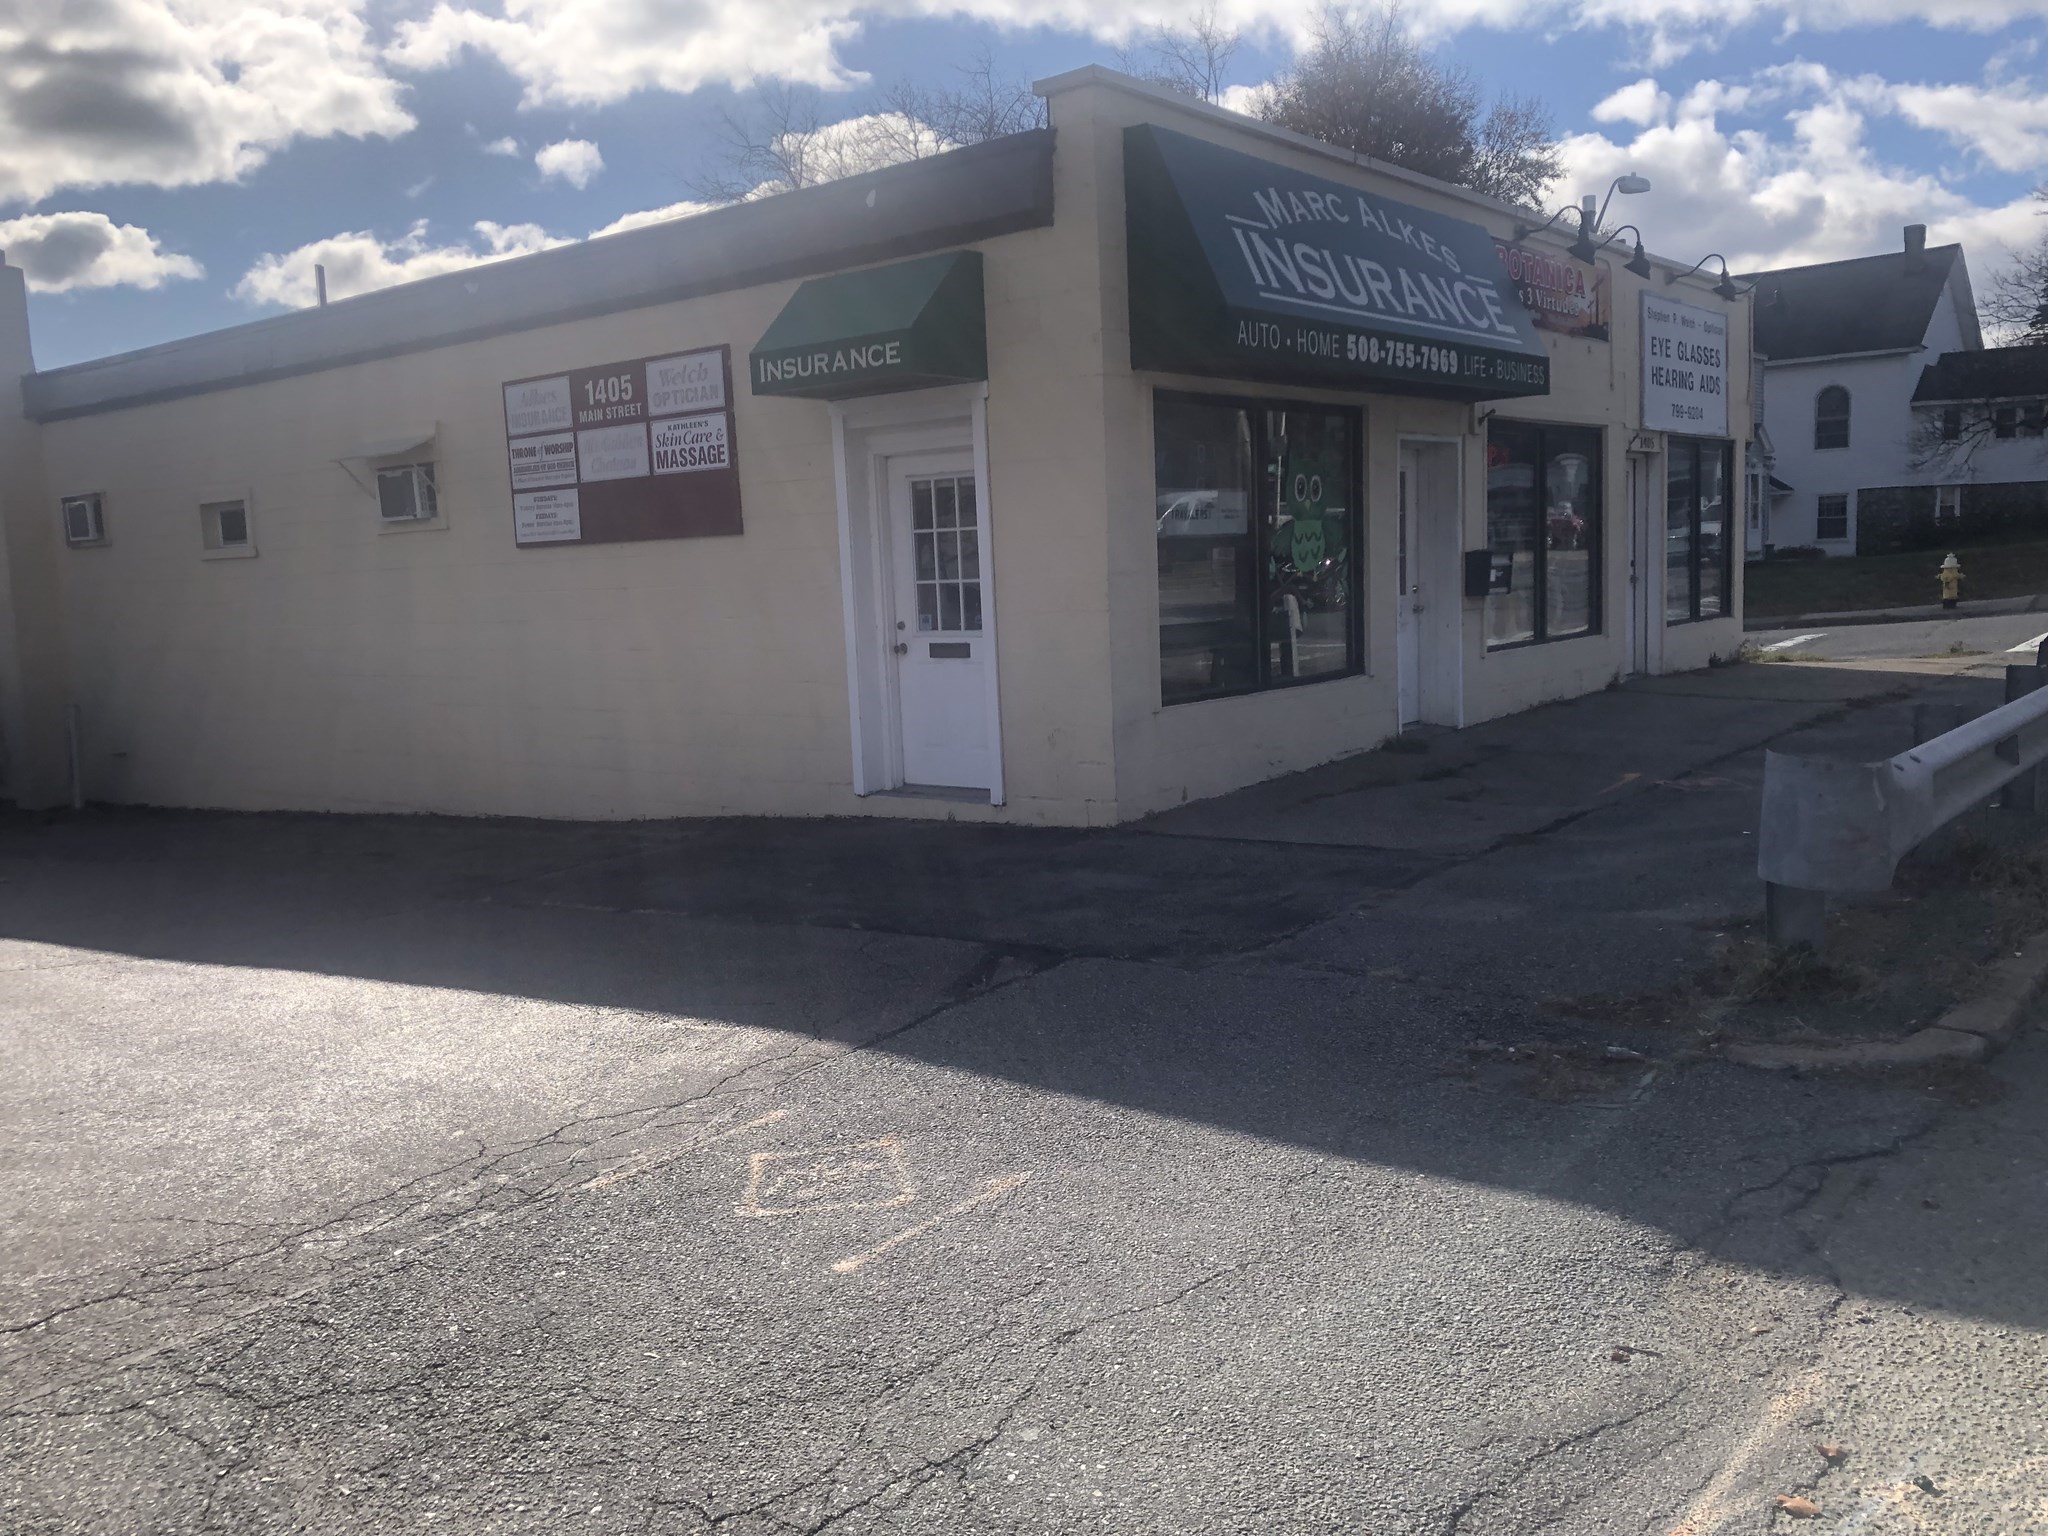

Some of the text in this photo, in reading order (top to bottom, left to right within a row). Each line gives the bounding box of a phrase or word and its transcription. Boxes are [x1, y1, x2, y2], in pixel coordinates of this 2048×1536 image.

[1252, 187, 1462, 273] MARC ALKES
[1232, 227, 1518, 334] INSURANCE
[759, 341, 901, 383] INSURANCE
[1237, 320, 1546, 385] AUTO HOME 508-755-7969 LIFE BUSINESS
[1651, 336, 1721, 368] EYE GLASSES
[585, 374, 633, 405] 1405
[652, 384, 718, 408] OPTICIAN
[1651, 365, 1721, 396] HEARING AIDS
[579, 402, 642, 424] MAIN STREET
[668, 420, 709, 432] KATHLEEN'S
[716, 428, 725, 442] &
[512, 446, 536, 460] THRONE
[544, 442, 574, 456] WORSHIP
[656, 444, 726, 470] MASSAGE
